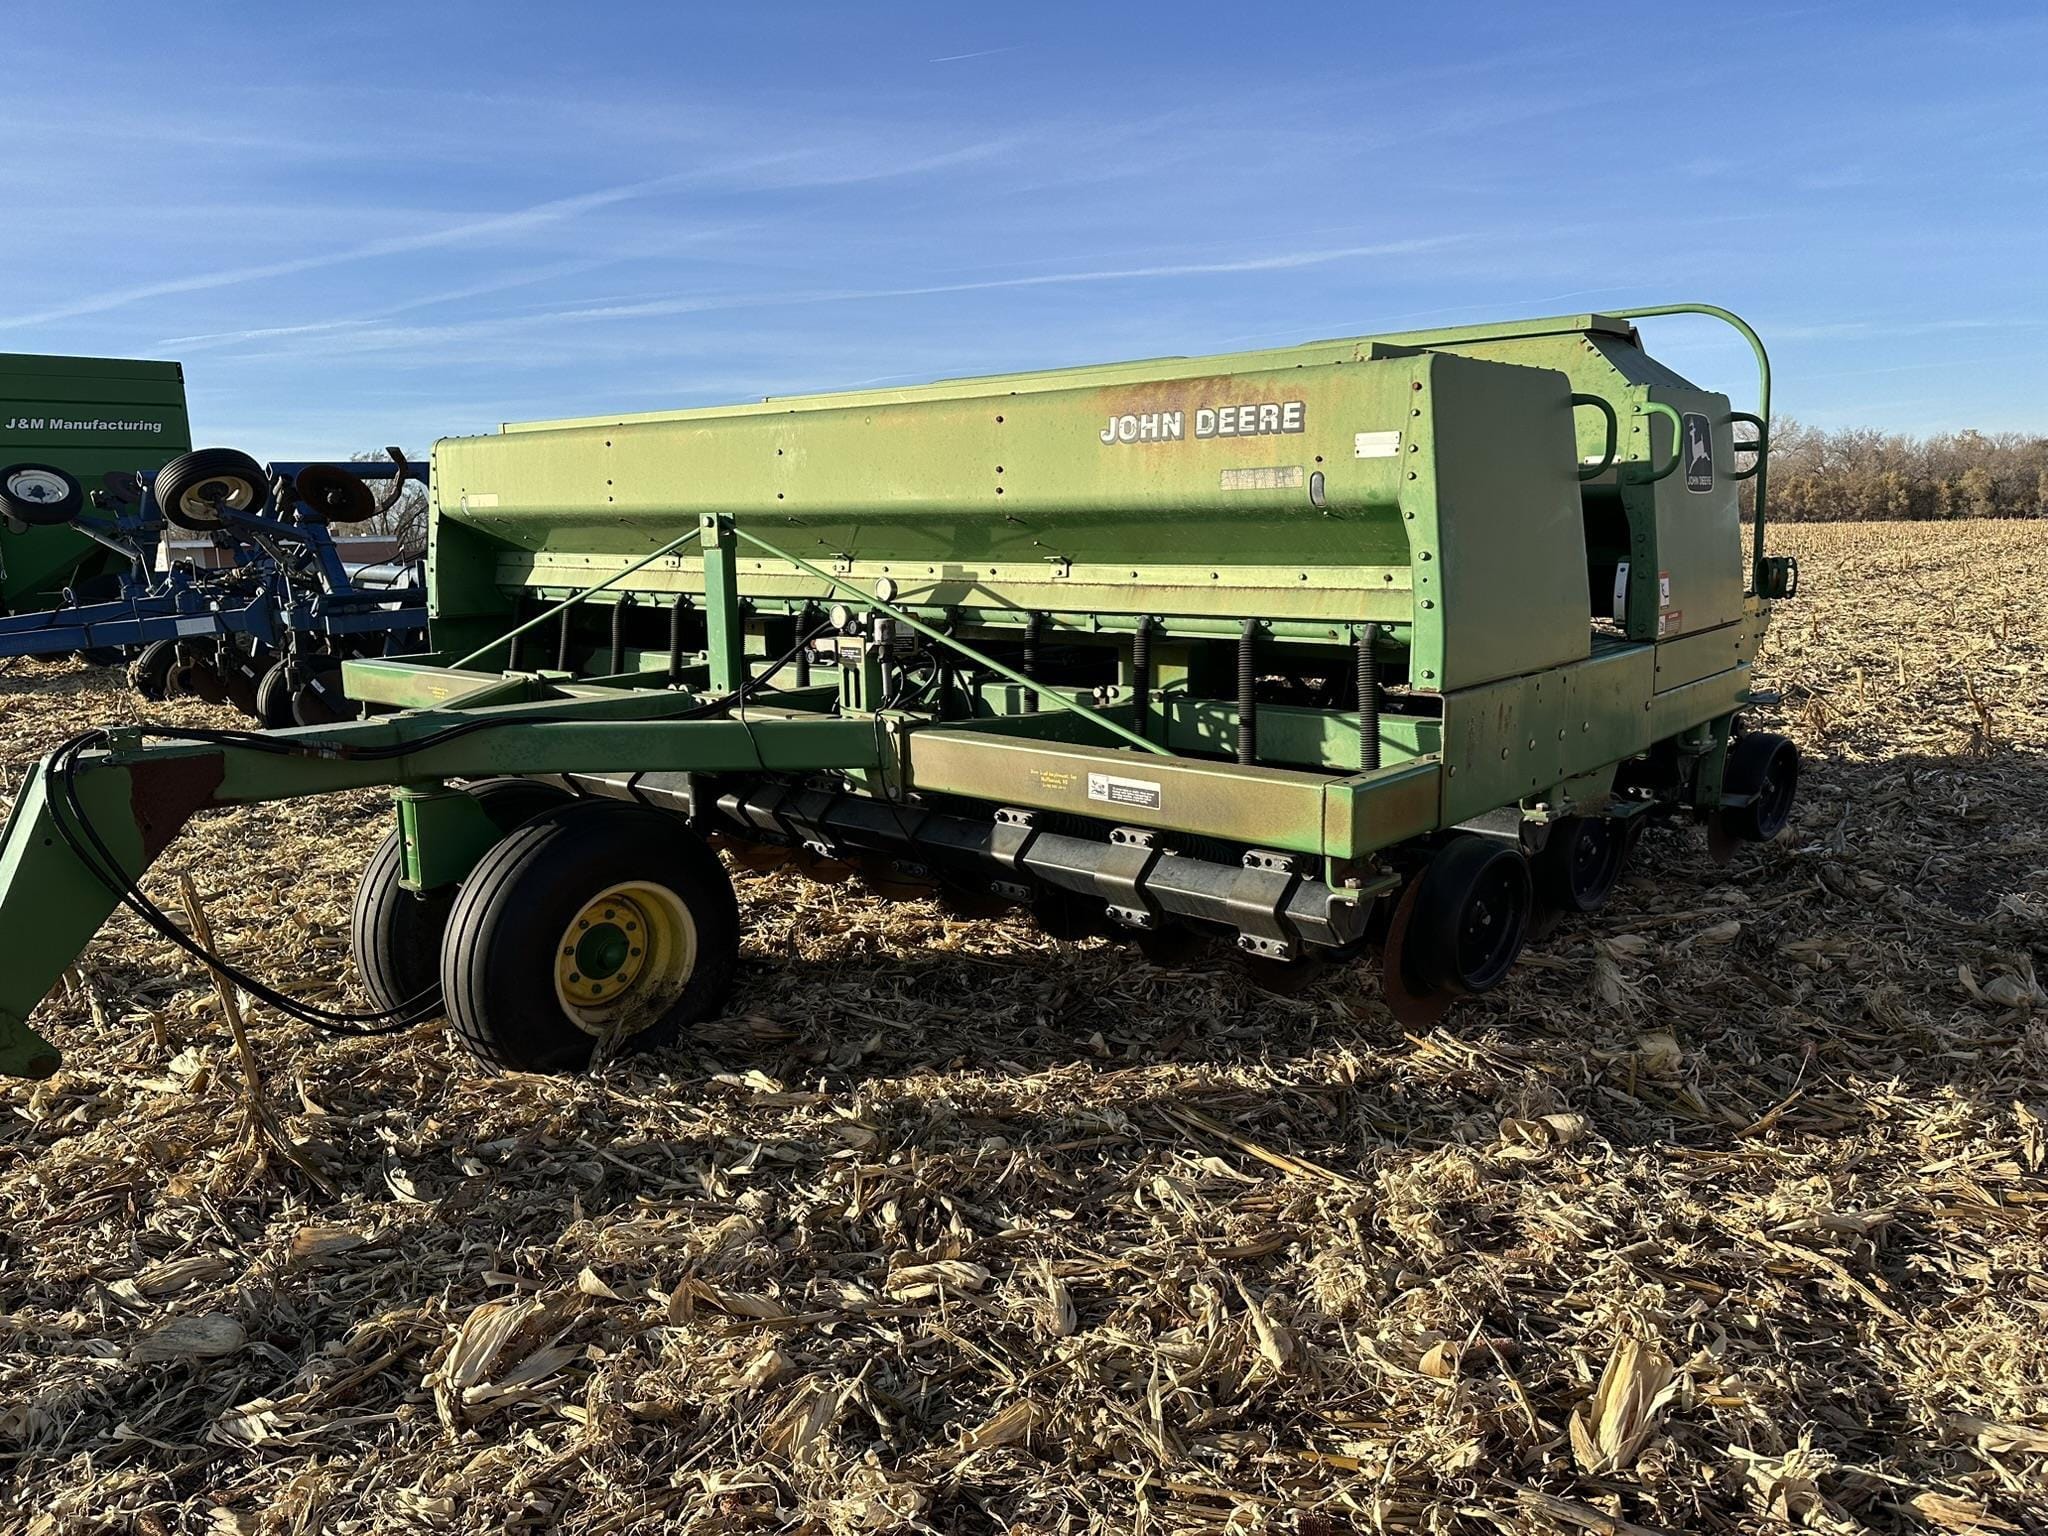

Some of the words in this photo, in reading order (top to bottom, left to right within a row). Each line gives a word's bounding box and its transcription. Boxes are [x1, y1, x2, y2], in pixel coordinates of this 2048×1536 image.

[5, 418, 44, 430] J&M
[49, 418, 162, 433] Manufacturing
[1100, 410, 1185, 445] JOHN
[1195, 400, 1306, 439] DEERE
